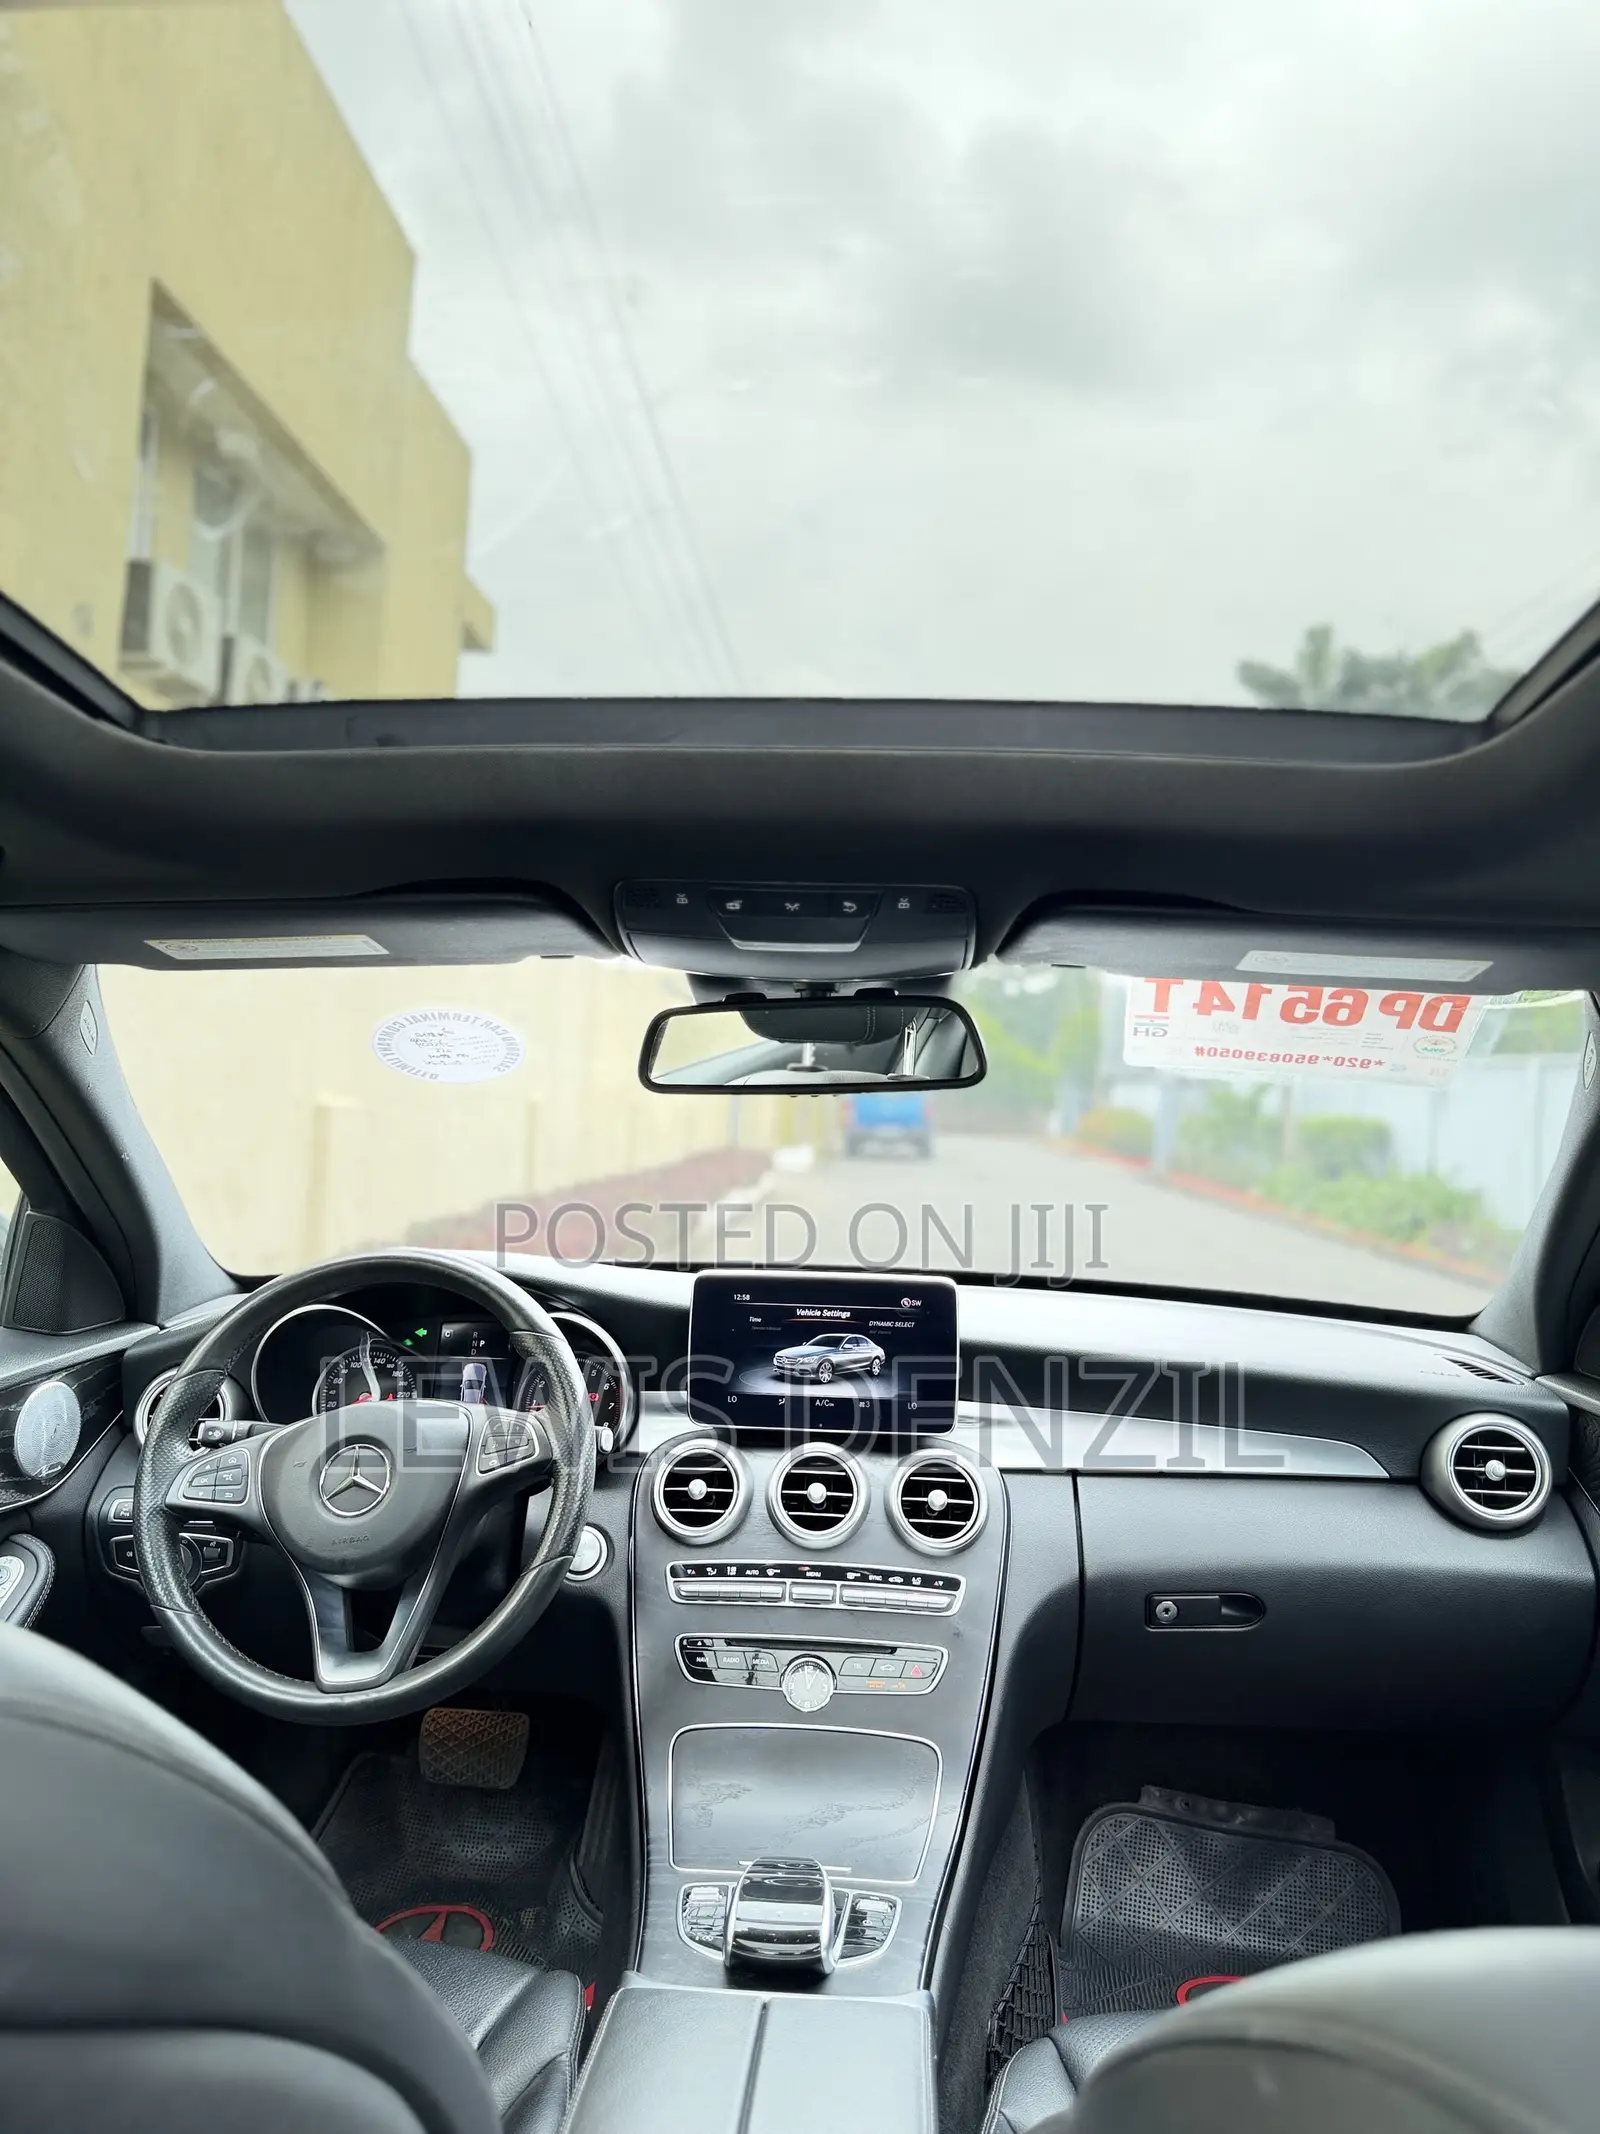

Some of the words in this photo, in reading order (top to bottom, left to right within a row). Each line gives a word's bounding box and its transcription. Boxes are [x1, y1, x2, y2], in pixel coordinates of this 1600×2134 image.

[733, 1293, 750, 1301] 12:58
[911, 1299, 922, 1307] SW
[796, 1308, 821, 1317] Vehicle
[822, 1309, 851, 1319] Settings
[868, 1320, 894, 1328] DYNAMIC
[894, 1321, 916, 1329] SELECT
[479, 1340, 486, 1348] P
[727, 1394, 738, 1403] LO
[907, 1402, 918, 1410] LO
[722, 1656, 740, 1665] RADIO
[752, 1658, 770, 1667] MEDIA
